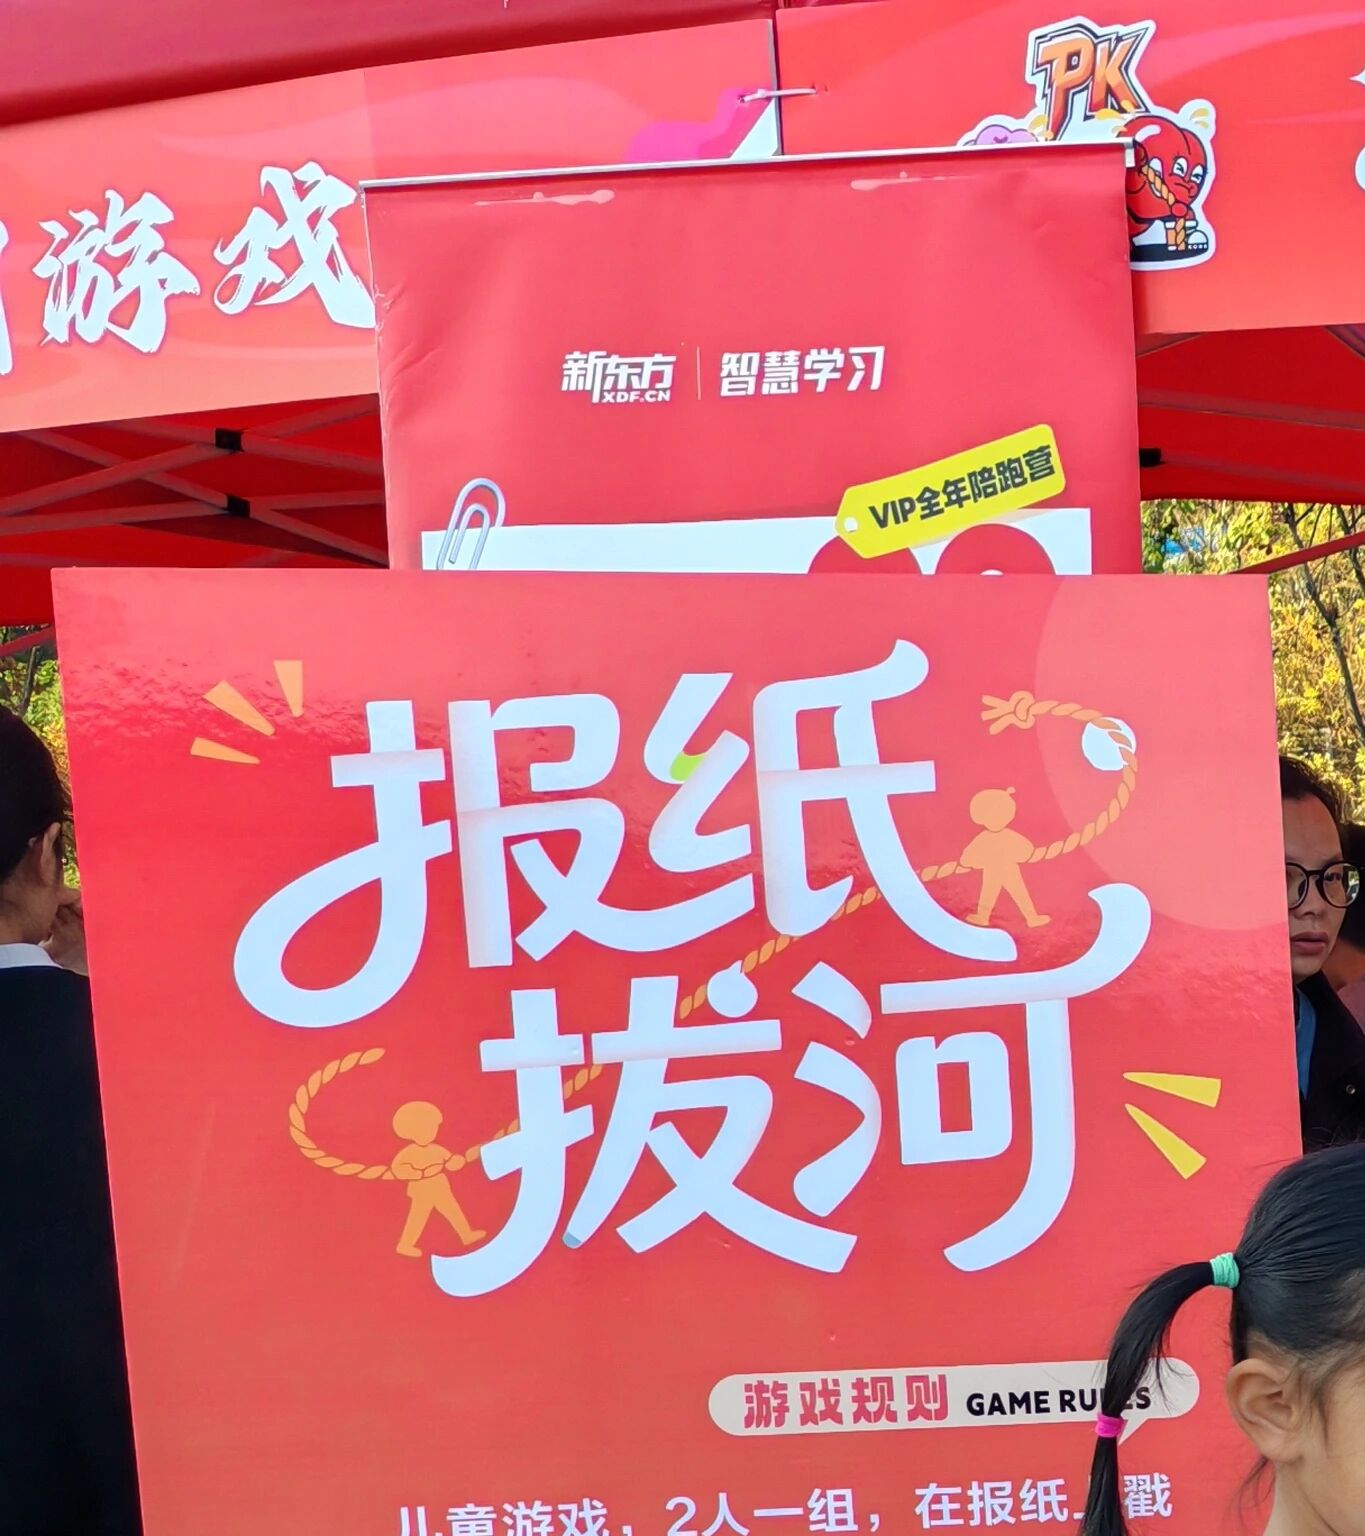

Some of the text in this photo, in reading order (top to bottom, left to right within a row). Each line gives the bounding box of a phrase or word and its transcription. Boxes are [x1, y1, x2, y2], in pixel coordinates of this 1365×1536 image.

[1033, 25, 1150, 141] PK
[0, 161, 376, 375] 游戏
[562, 345, 886, 402] 新东方 智慧学习
[601, 389, 672, 404] XDF.CN
[867, 444, 1057, 530] VIP全年陪跑营
[234, 639, 1017, 1029] 报纸
[430, 883, 1152, 1297] 拔河
[741, 1372, 1151, 1430] 游戏规则 GAME RUS
